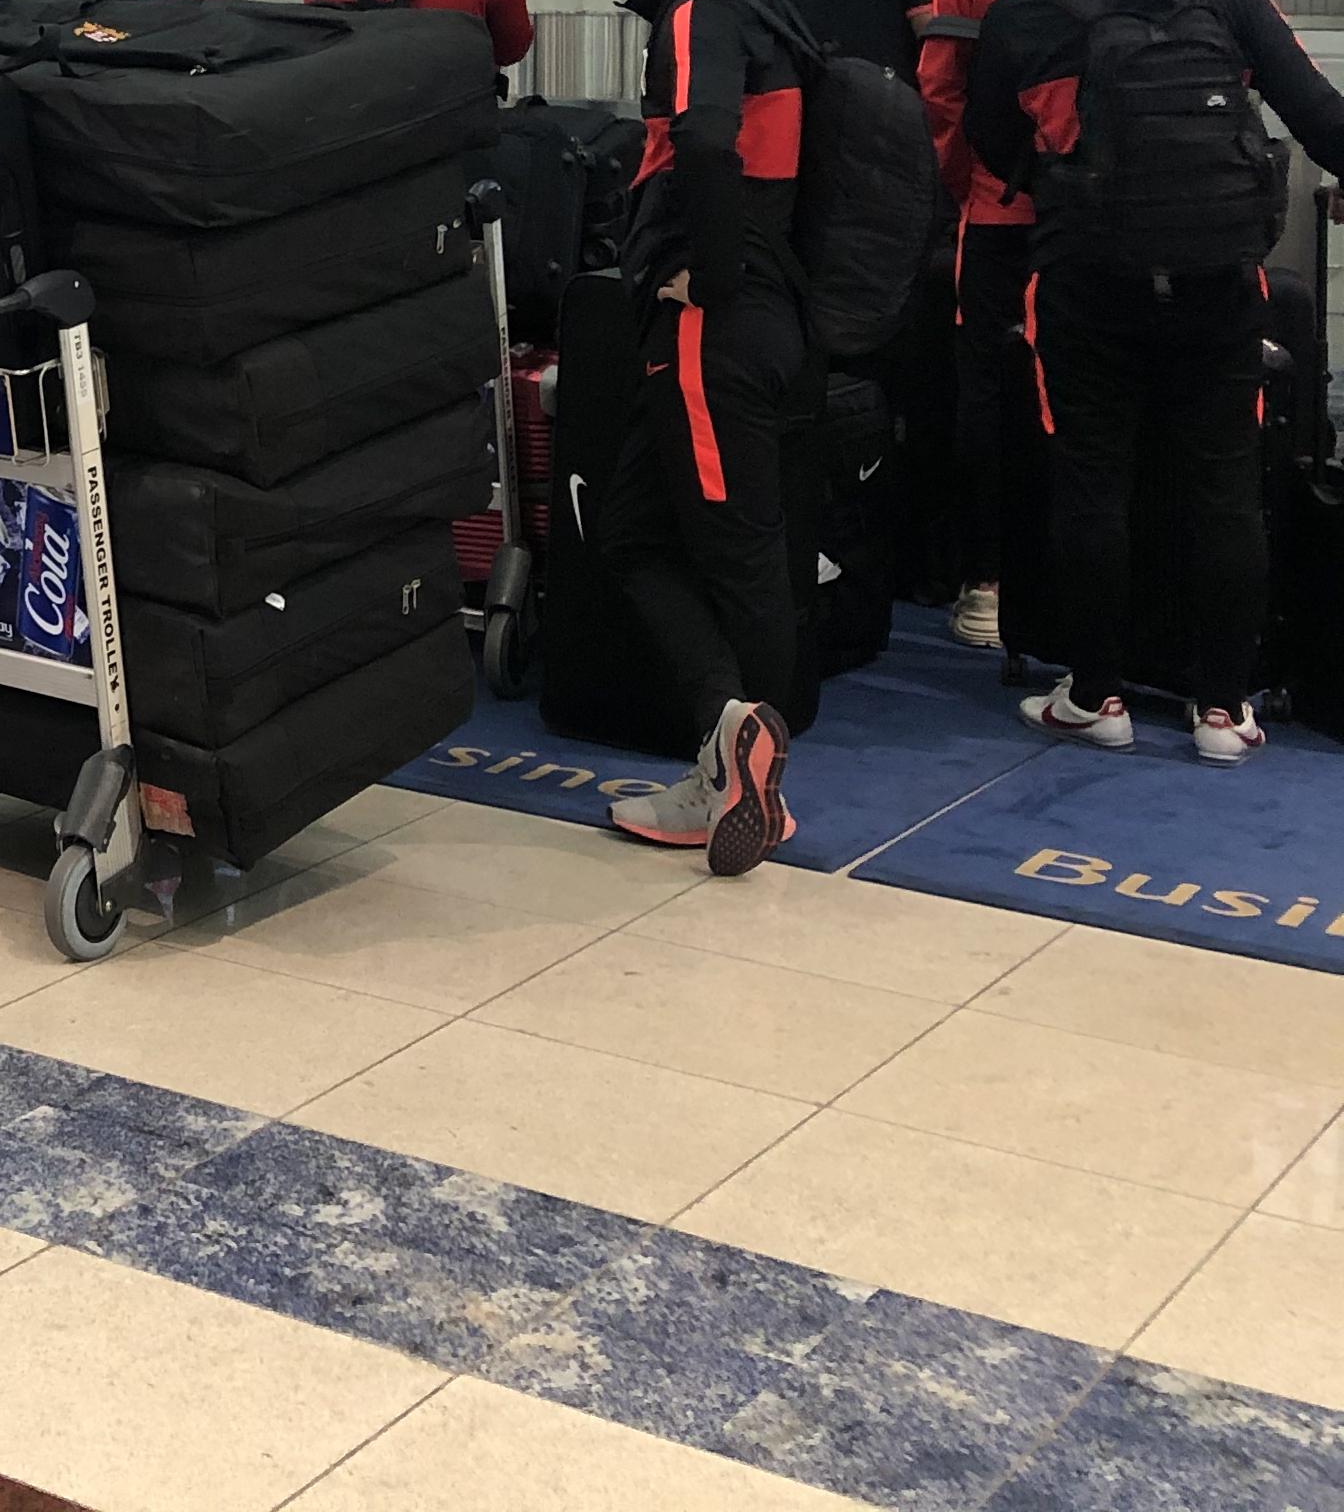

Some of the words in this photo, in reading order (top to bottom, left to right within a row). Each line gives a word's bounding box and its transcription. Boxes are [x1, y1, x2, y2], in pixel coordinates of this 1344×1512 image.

[88, 466, 109, 591] PASSENGER
[101, 594, 120, 692] TROLLEY
[429, 744, 667, 800] sine
[1014, 848, 1344, 936] Busi
